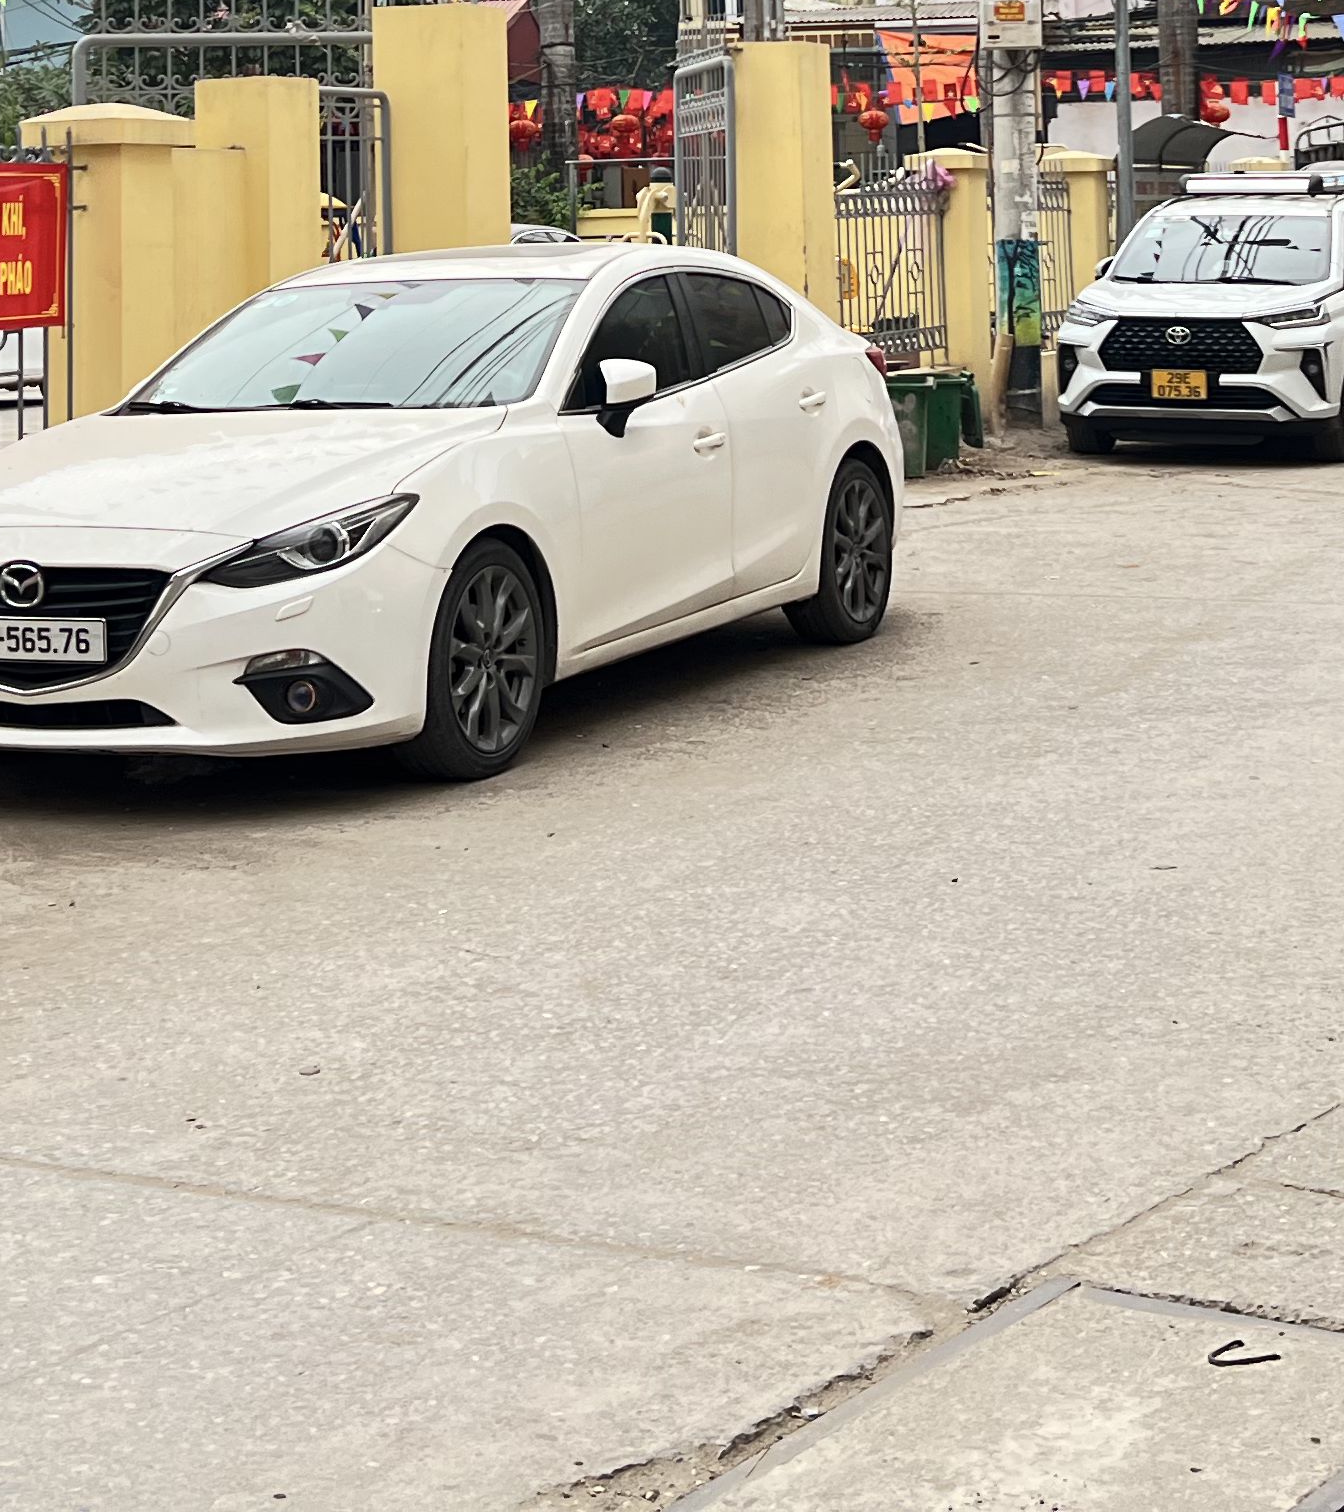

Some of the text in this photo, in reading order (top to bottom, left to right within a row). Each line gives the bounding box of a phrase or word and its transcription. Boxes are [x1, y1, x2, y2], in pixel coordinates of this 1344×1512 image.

[1, 194, 27, 240] KHÍ,
[0, 253, 33, 296] PHÁO
[1157, 385, 1201, 398] 075.36
[1166, 372, 1191, 385] 29E
